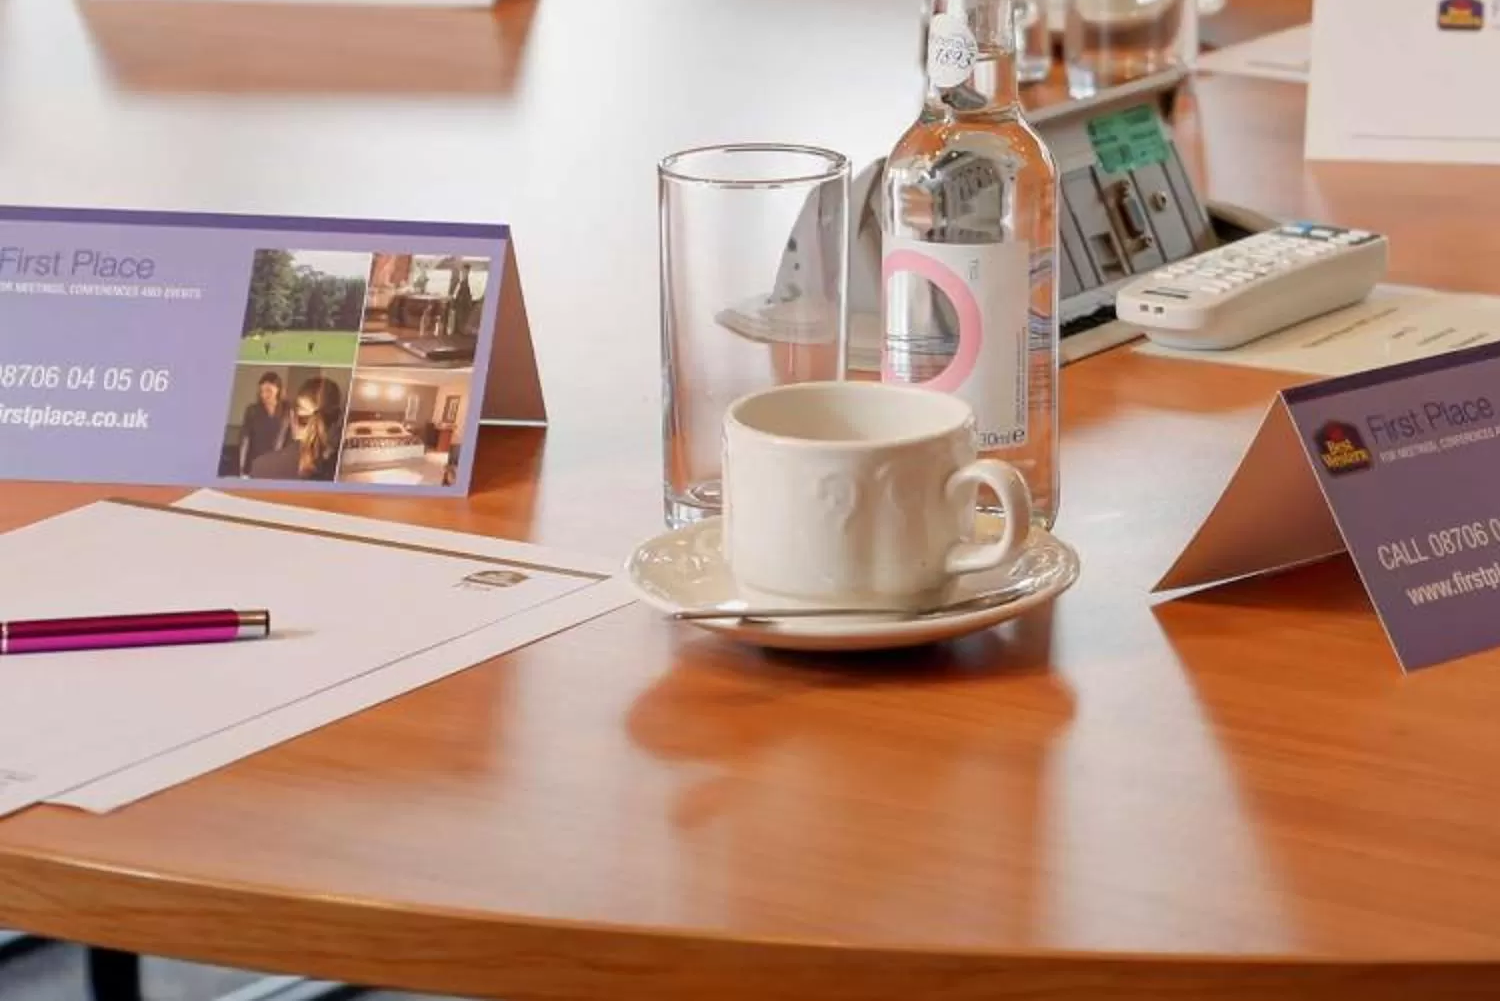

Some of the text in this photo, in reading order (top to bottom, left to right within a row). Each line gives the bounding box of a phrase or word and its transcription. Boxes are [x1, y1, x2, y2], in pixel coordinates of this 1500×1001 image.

[0, 246, 156, 280] First Place
[0, 364, 170, 393] 8706 04 05 06
[0, 402, 149, 430] irstplace.co.uk
[1366, 396, 1495, 444] First Place
[1377, 537, 1429, 570] CALL
[1428, 521, 1489, 557] 08706
